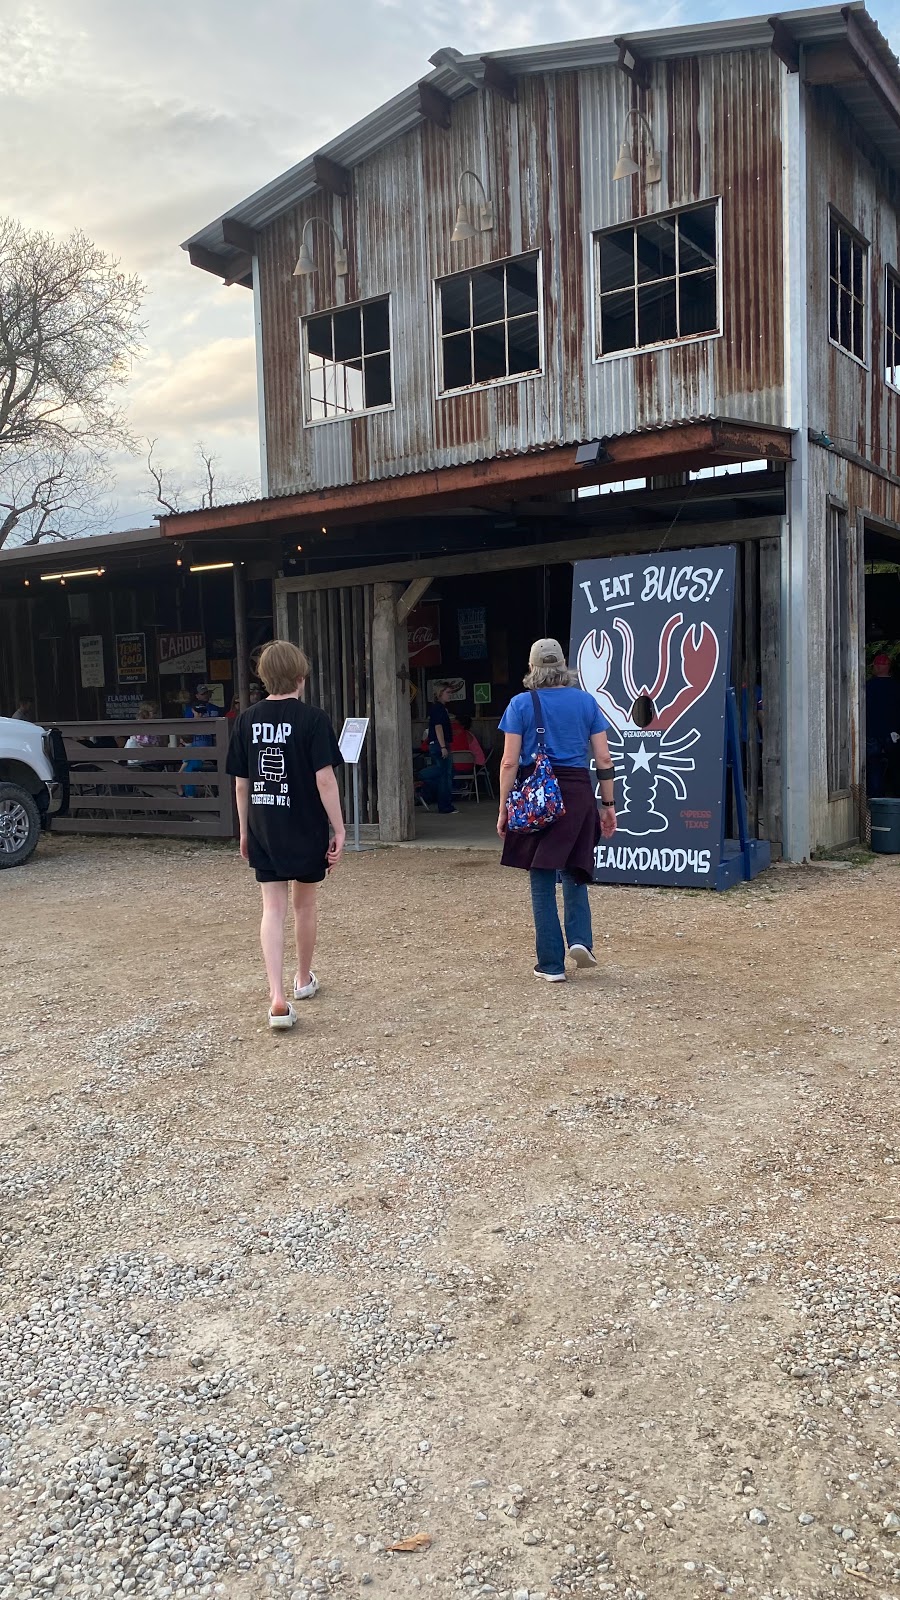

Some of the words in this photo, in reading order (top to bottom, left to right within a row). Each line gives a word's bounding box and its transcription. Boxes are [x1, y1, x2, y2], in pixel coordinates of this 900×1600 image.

[579, 580, 599, 613] I
[600, 572, 634, 601] EAT
[640, 566, 724, 603] BUGS!
[120, 654, 143, 668] GOLD
[252, 722, 292, 744] PDAP
[253, 781, 267, 792] EST.
[276, 795, 286, 806] WE
[680, 810, 712, 819] CYPRESS
[685, 820, 710, 829] TEXAS
